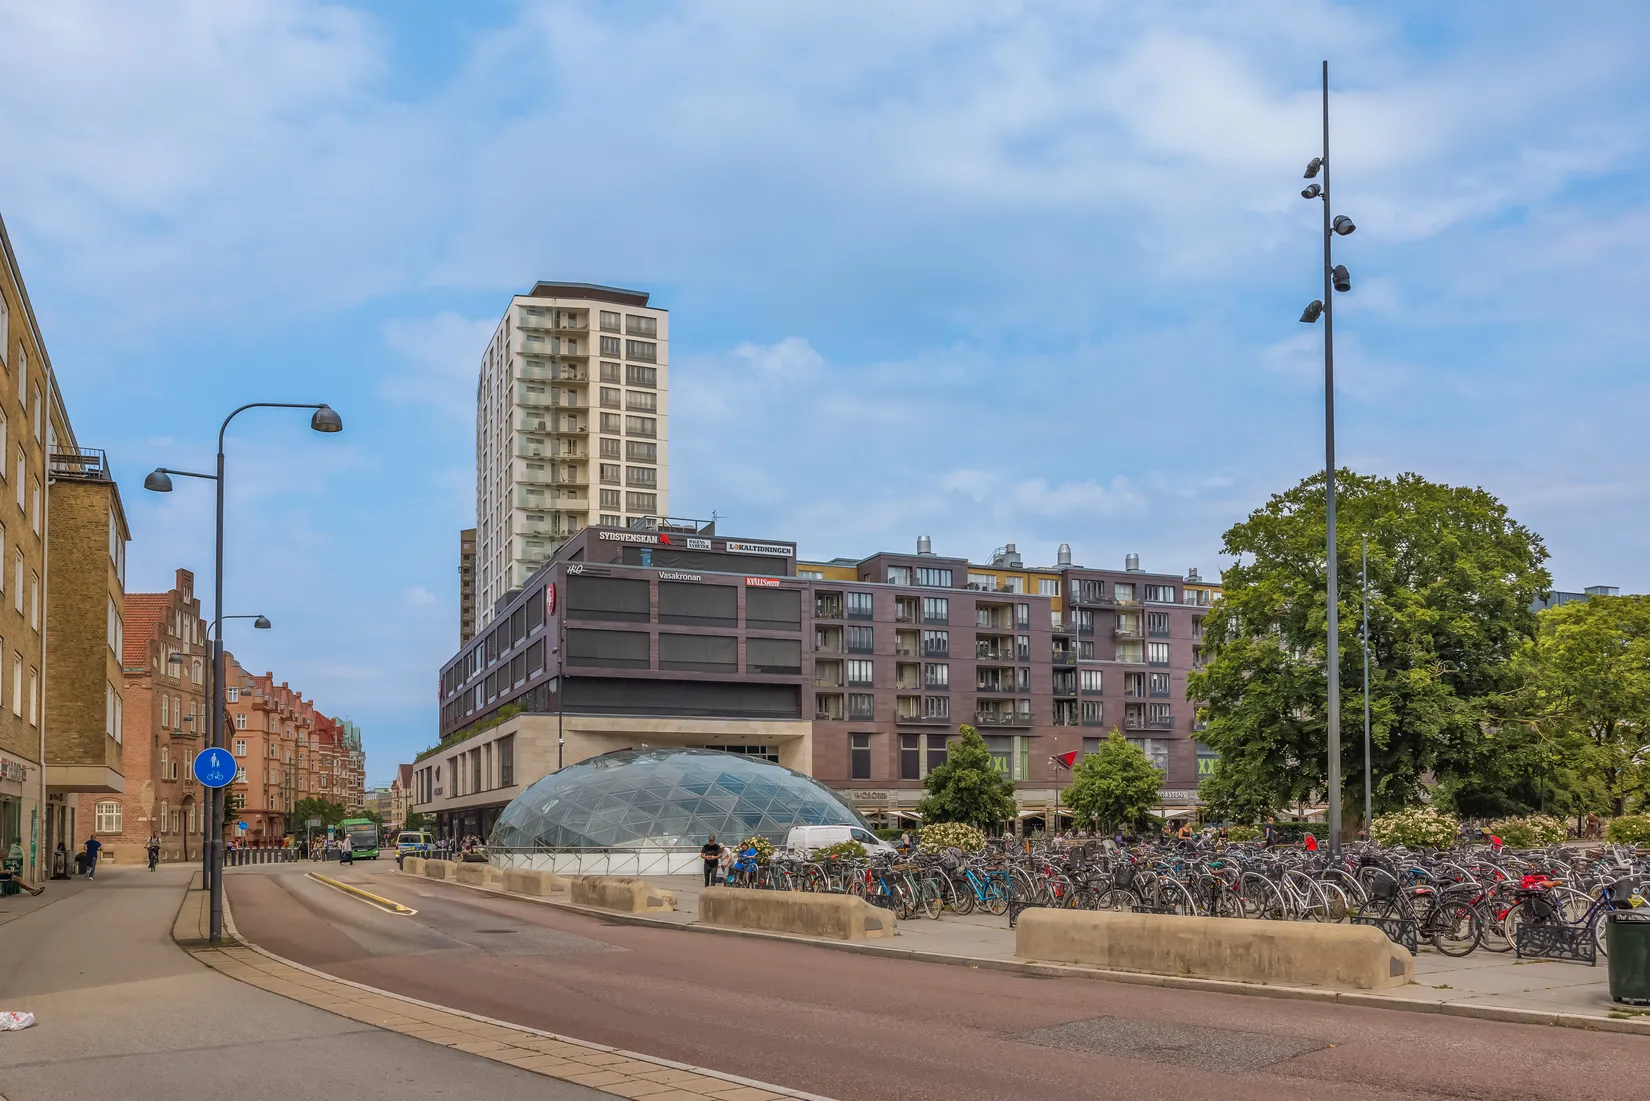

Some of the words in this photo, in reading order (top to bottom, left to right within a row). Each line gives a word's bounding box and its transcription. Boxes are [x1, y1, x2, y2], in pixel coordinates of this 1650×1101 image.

[599, 531, 658, 544] SYDSVENSKAN
[729, 543, 791, 554] LOKALTIDNINGEN
[658, 571, 702, 582] Vasakronan
[1197, 758, 1219, 774] XX
